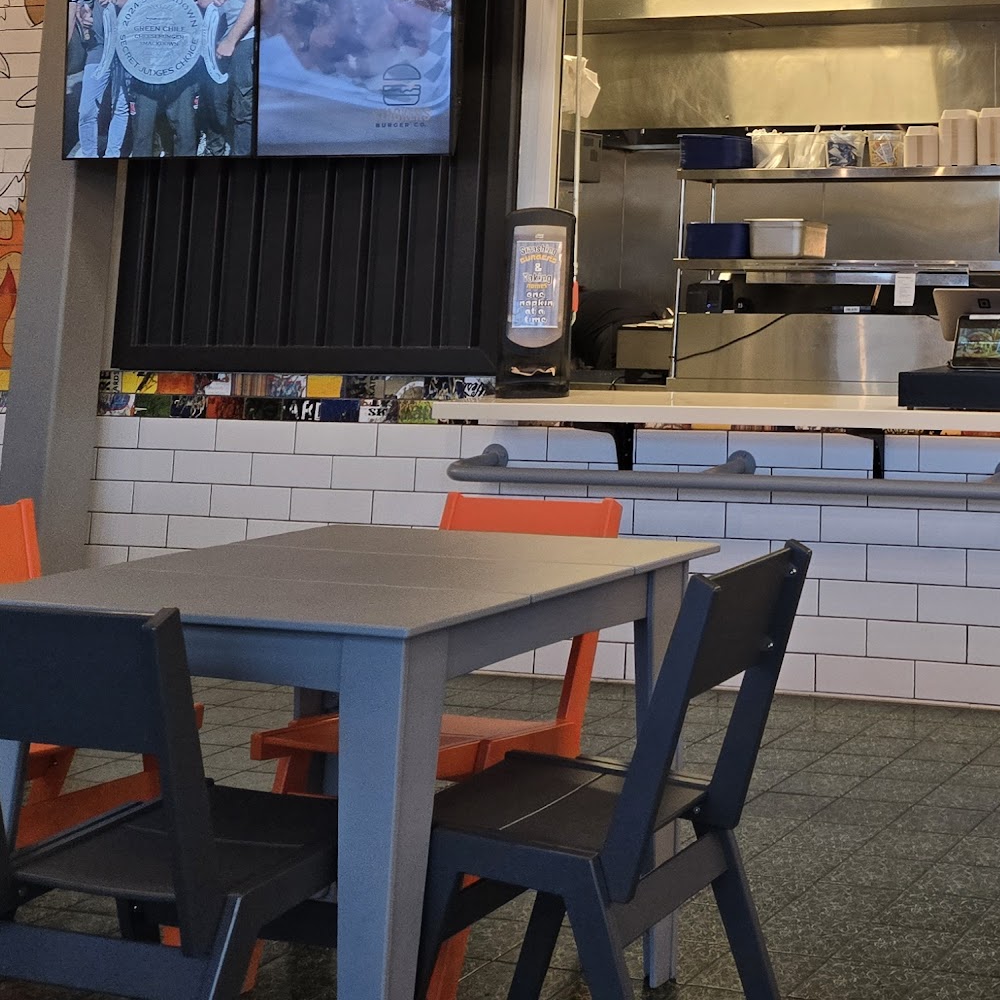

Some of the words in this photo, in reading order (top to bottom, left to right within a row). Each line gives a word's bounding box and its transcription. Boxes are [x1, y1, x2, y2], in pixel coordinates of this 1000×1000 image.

[120, 35, 140, 68] SECRET
[176, 38, 198, 70] CHOICE
[535, 263, 542, 271] &
